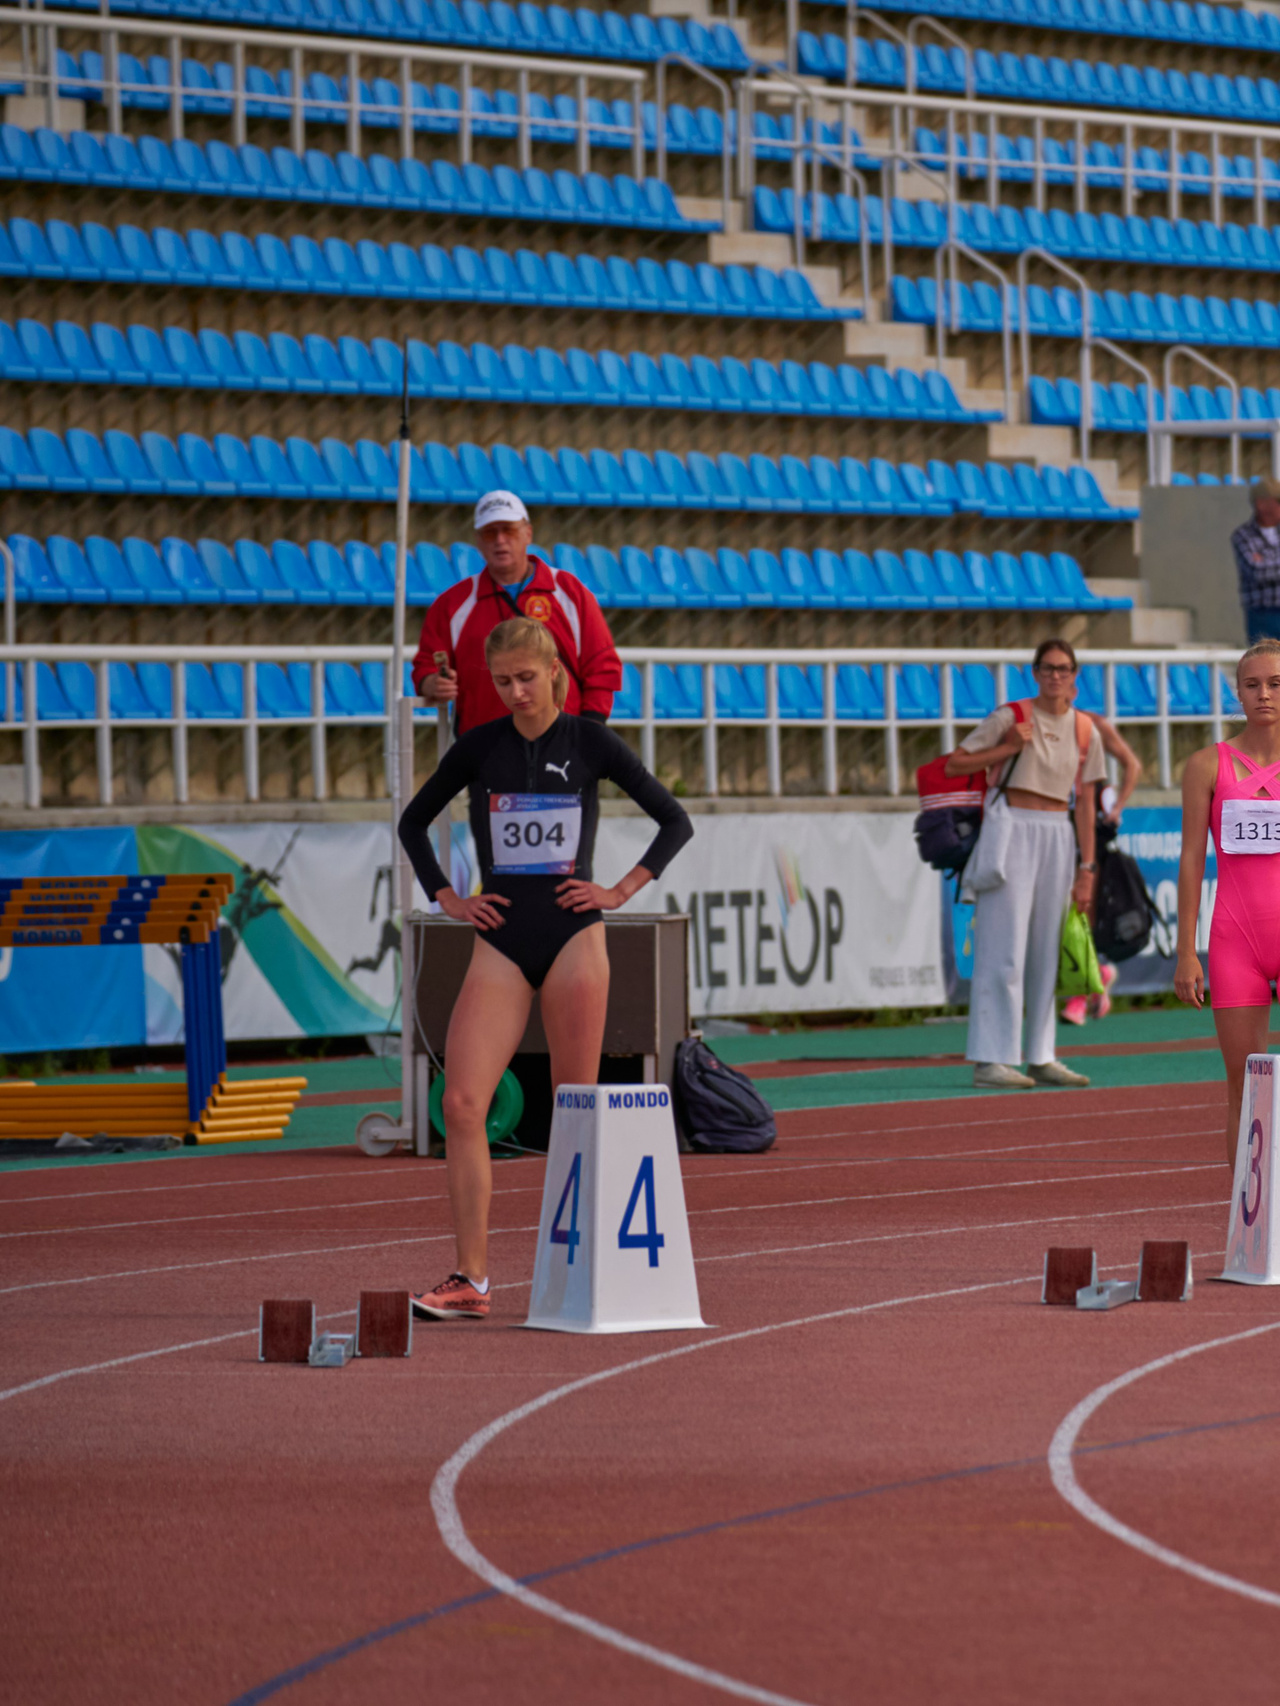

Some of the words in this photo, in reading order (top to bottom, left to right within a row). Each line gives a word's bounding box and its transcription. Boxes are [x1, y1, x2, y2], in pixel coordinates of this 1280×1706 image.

[503, 821, 565, 848] 304
[12, 928, 83, 944] MONDO
[1247, 1059, 1273, 1076] MONDO
[557, 1091, 596, 1110] MONDO
[608, 1091, 669, 1109] MONDO
[1241, 1118, 1263, 1227] 3
[550, 1152, 582, 1265] 4
[618, 1155, 665, 1268] 4
